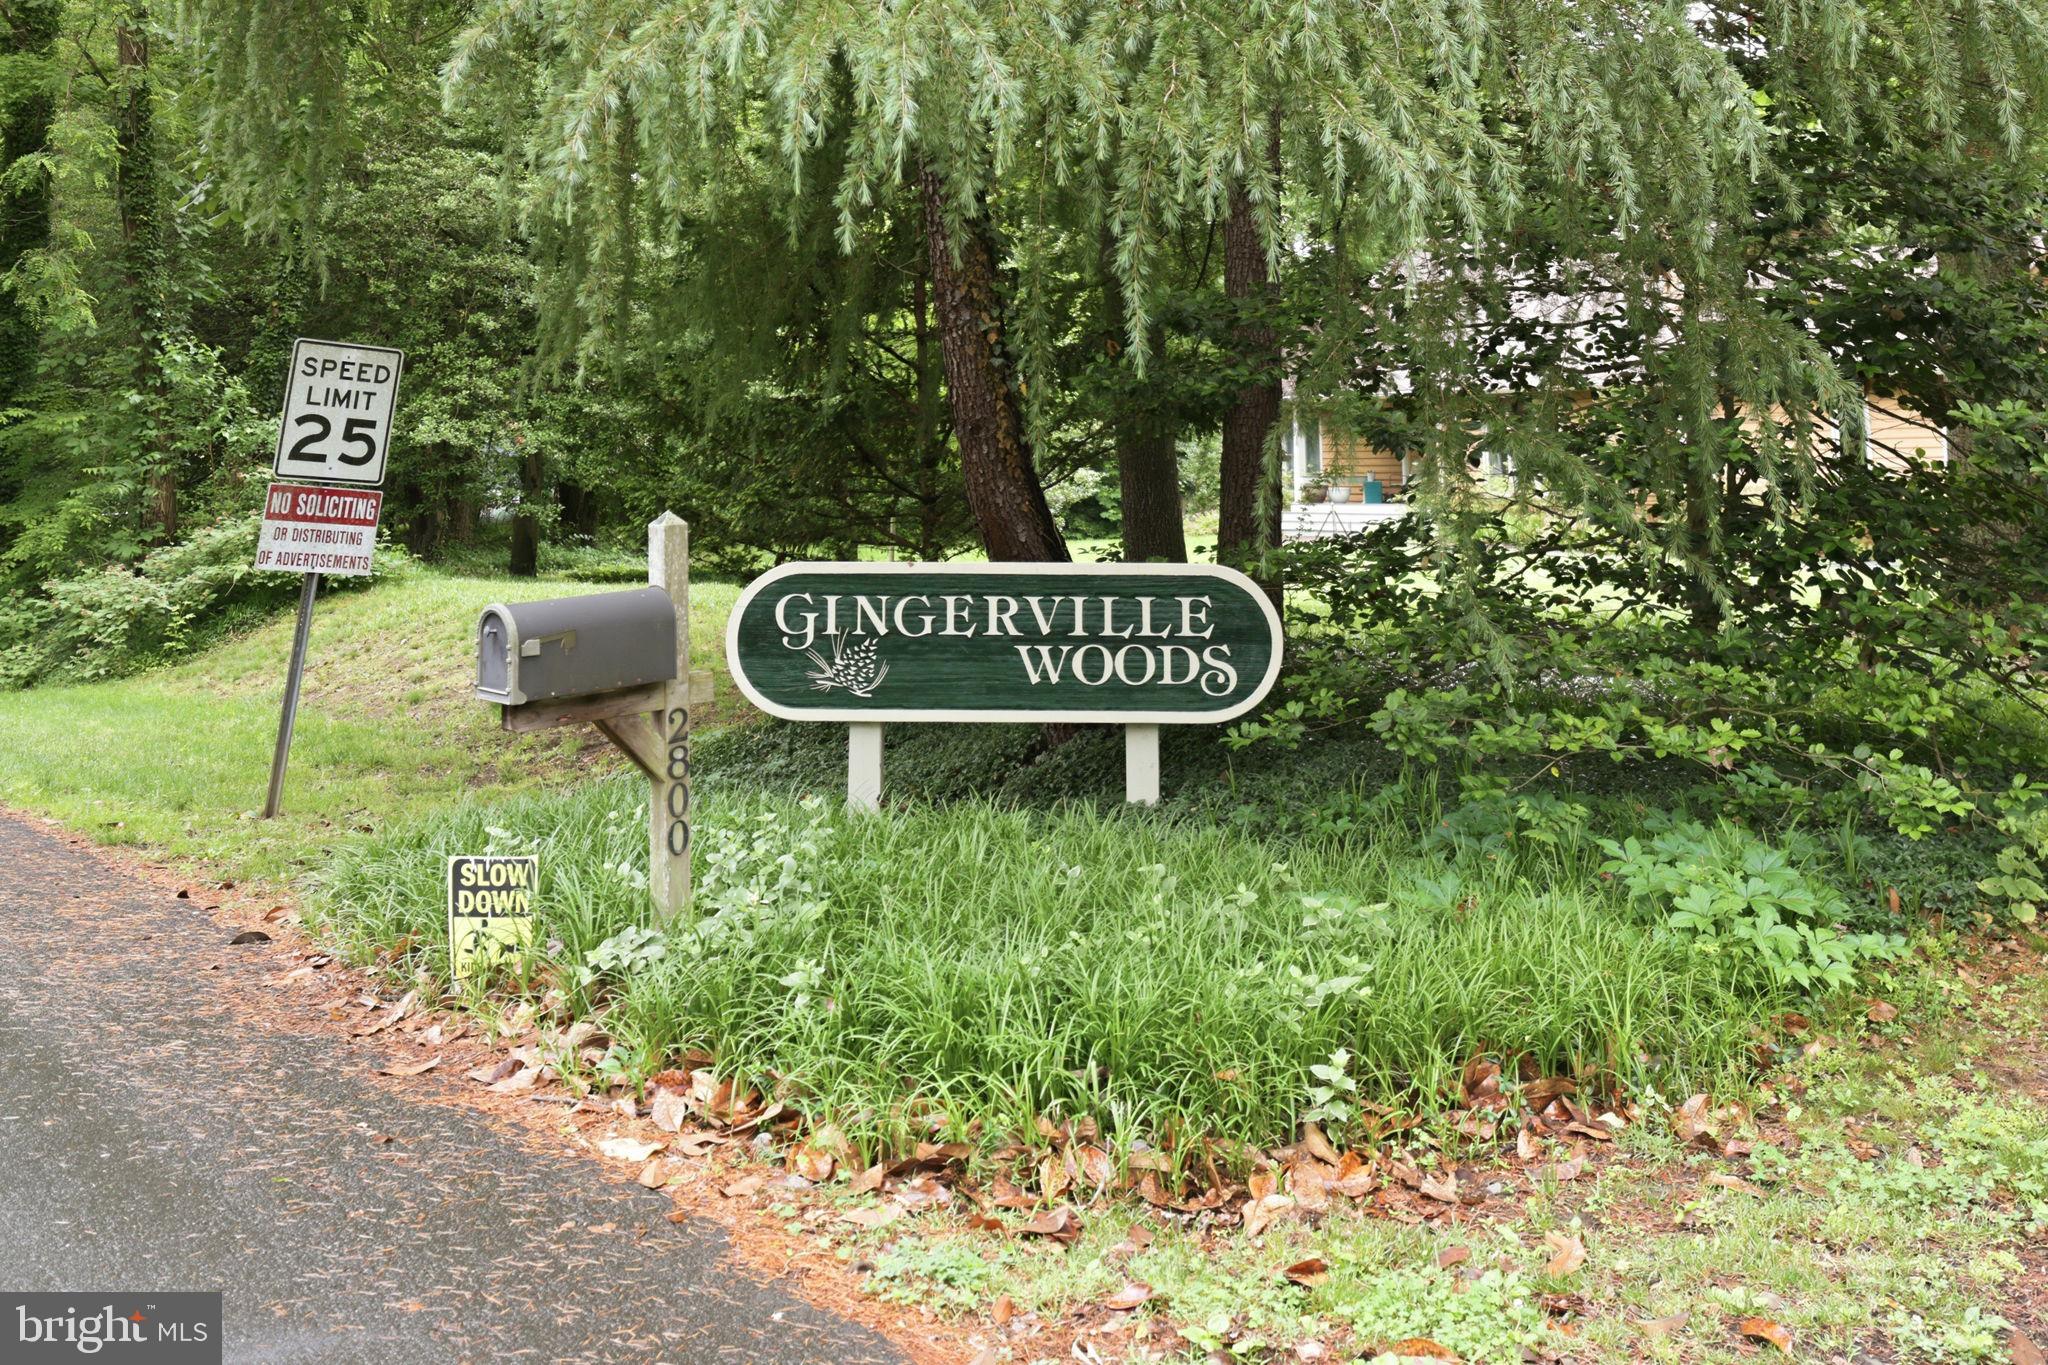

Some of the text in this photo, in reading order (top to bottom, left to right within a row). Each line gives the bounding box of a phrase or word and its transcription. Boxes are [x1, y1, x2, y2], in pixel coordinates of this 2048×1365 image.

[301, 357, 391, 384] SPEED
[306, 386, 377, 411] LIMIT
[287, 414, 378, 466] 25
[269, 492, 376, 520] NO SOLICITING
[273, 527, 363, 546] OR DISTRIBUTING
[258, 550, 369, 571] OF ADVERTISEMENTS
[775, 593, 1214, 650] GINGERVILLE
[1013, 643, 1238, 696] WOODS
[667, 707, 690, 856] 2800
[460, 863, 529, 887] SLOW
[458, 889, 529, 914] DOWN
